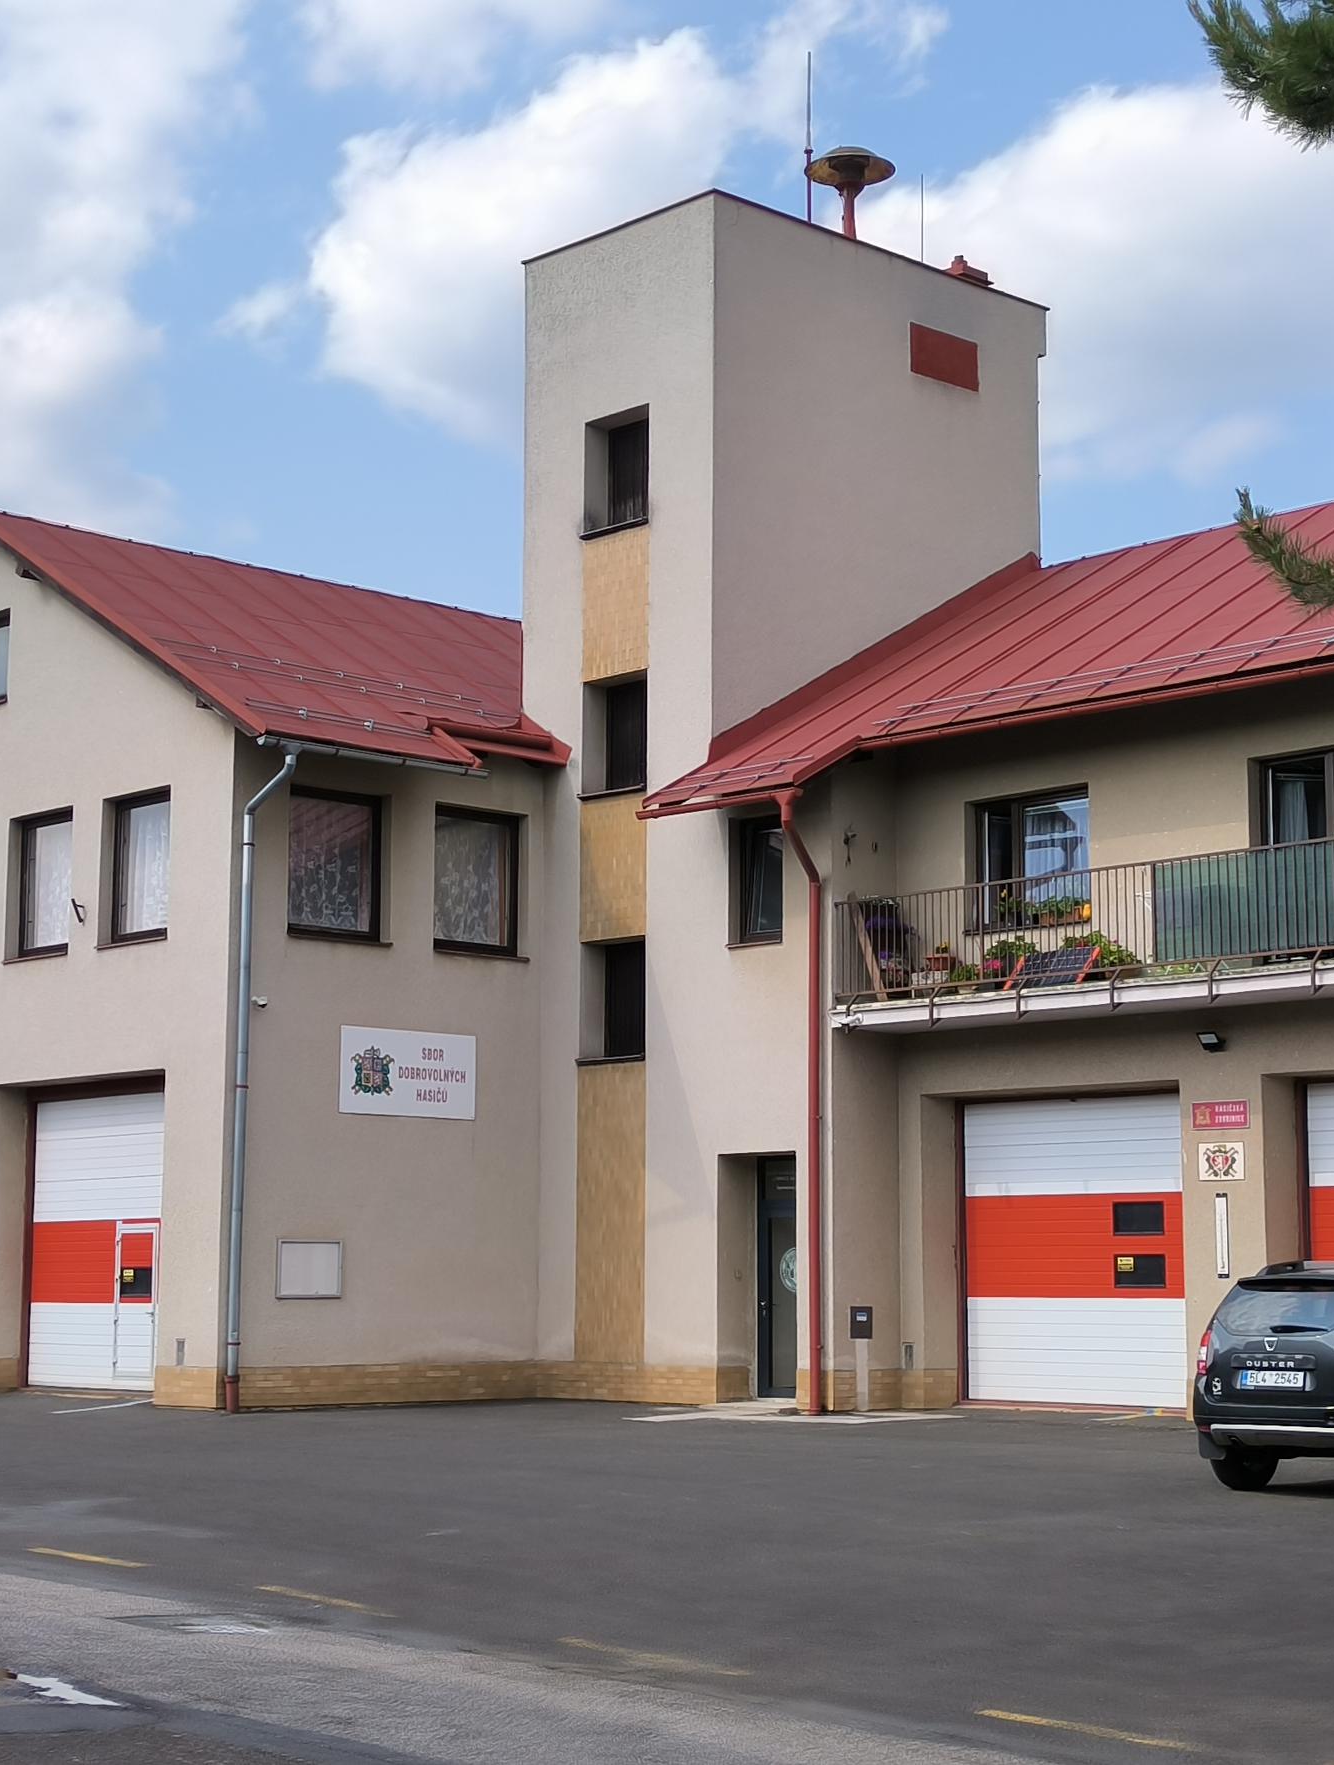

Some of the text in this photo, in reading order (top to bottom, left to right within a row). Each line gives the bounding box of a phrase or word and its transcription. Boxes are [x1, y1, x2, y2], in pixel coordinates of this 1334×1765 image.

[421, 1047, 444, 1062] SBOR
[398, 1066, 466, 1083] DOBROVOLNÝCH
[1246, 1360, 1295, 1369] DUSTER
[1249, 1372, 1300, 1385] 5L4 2545
